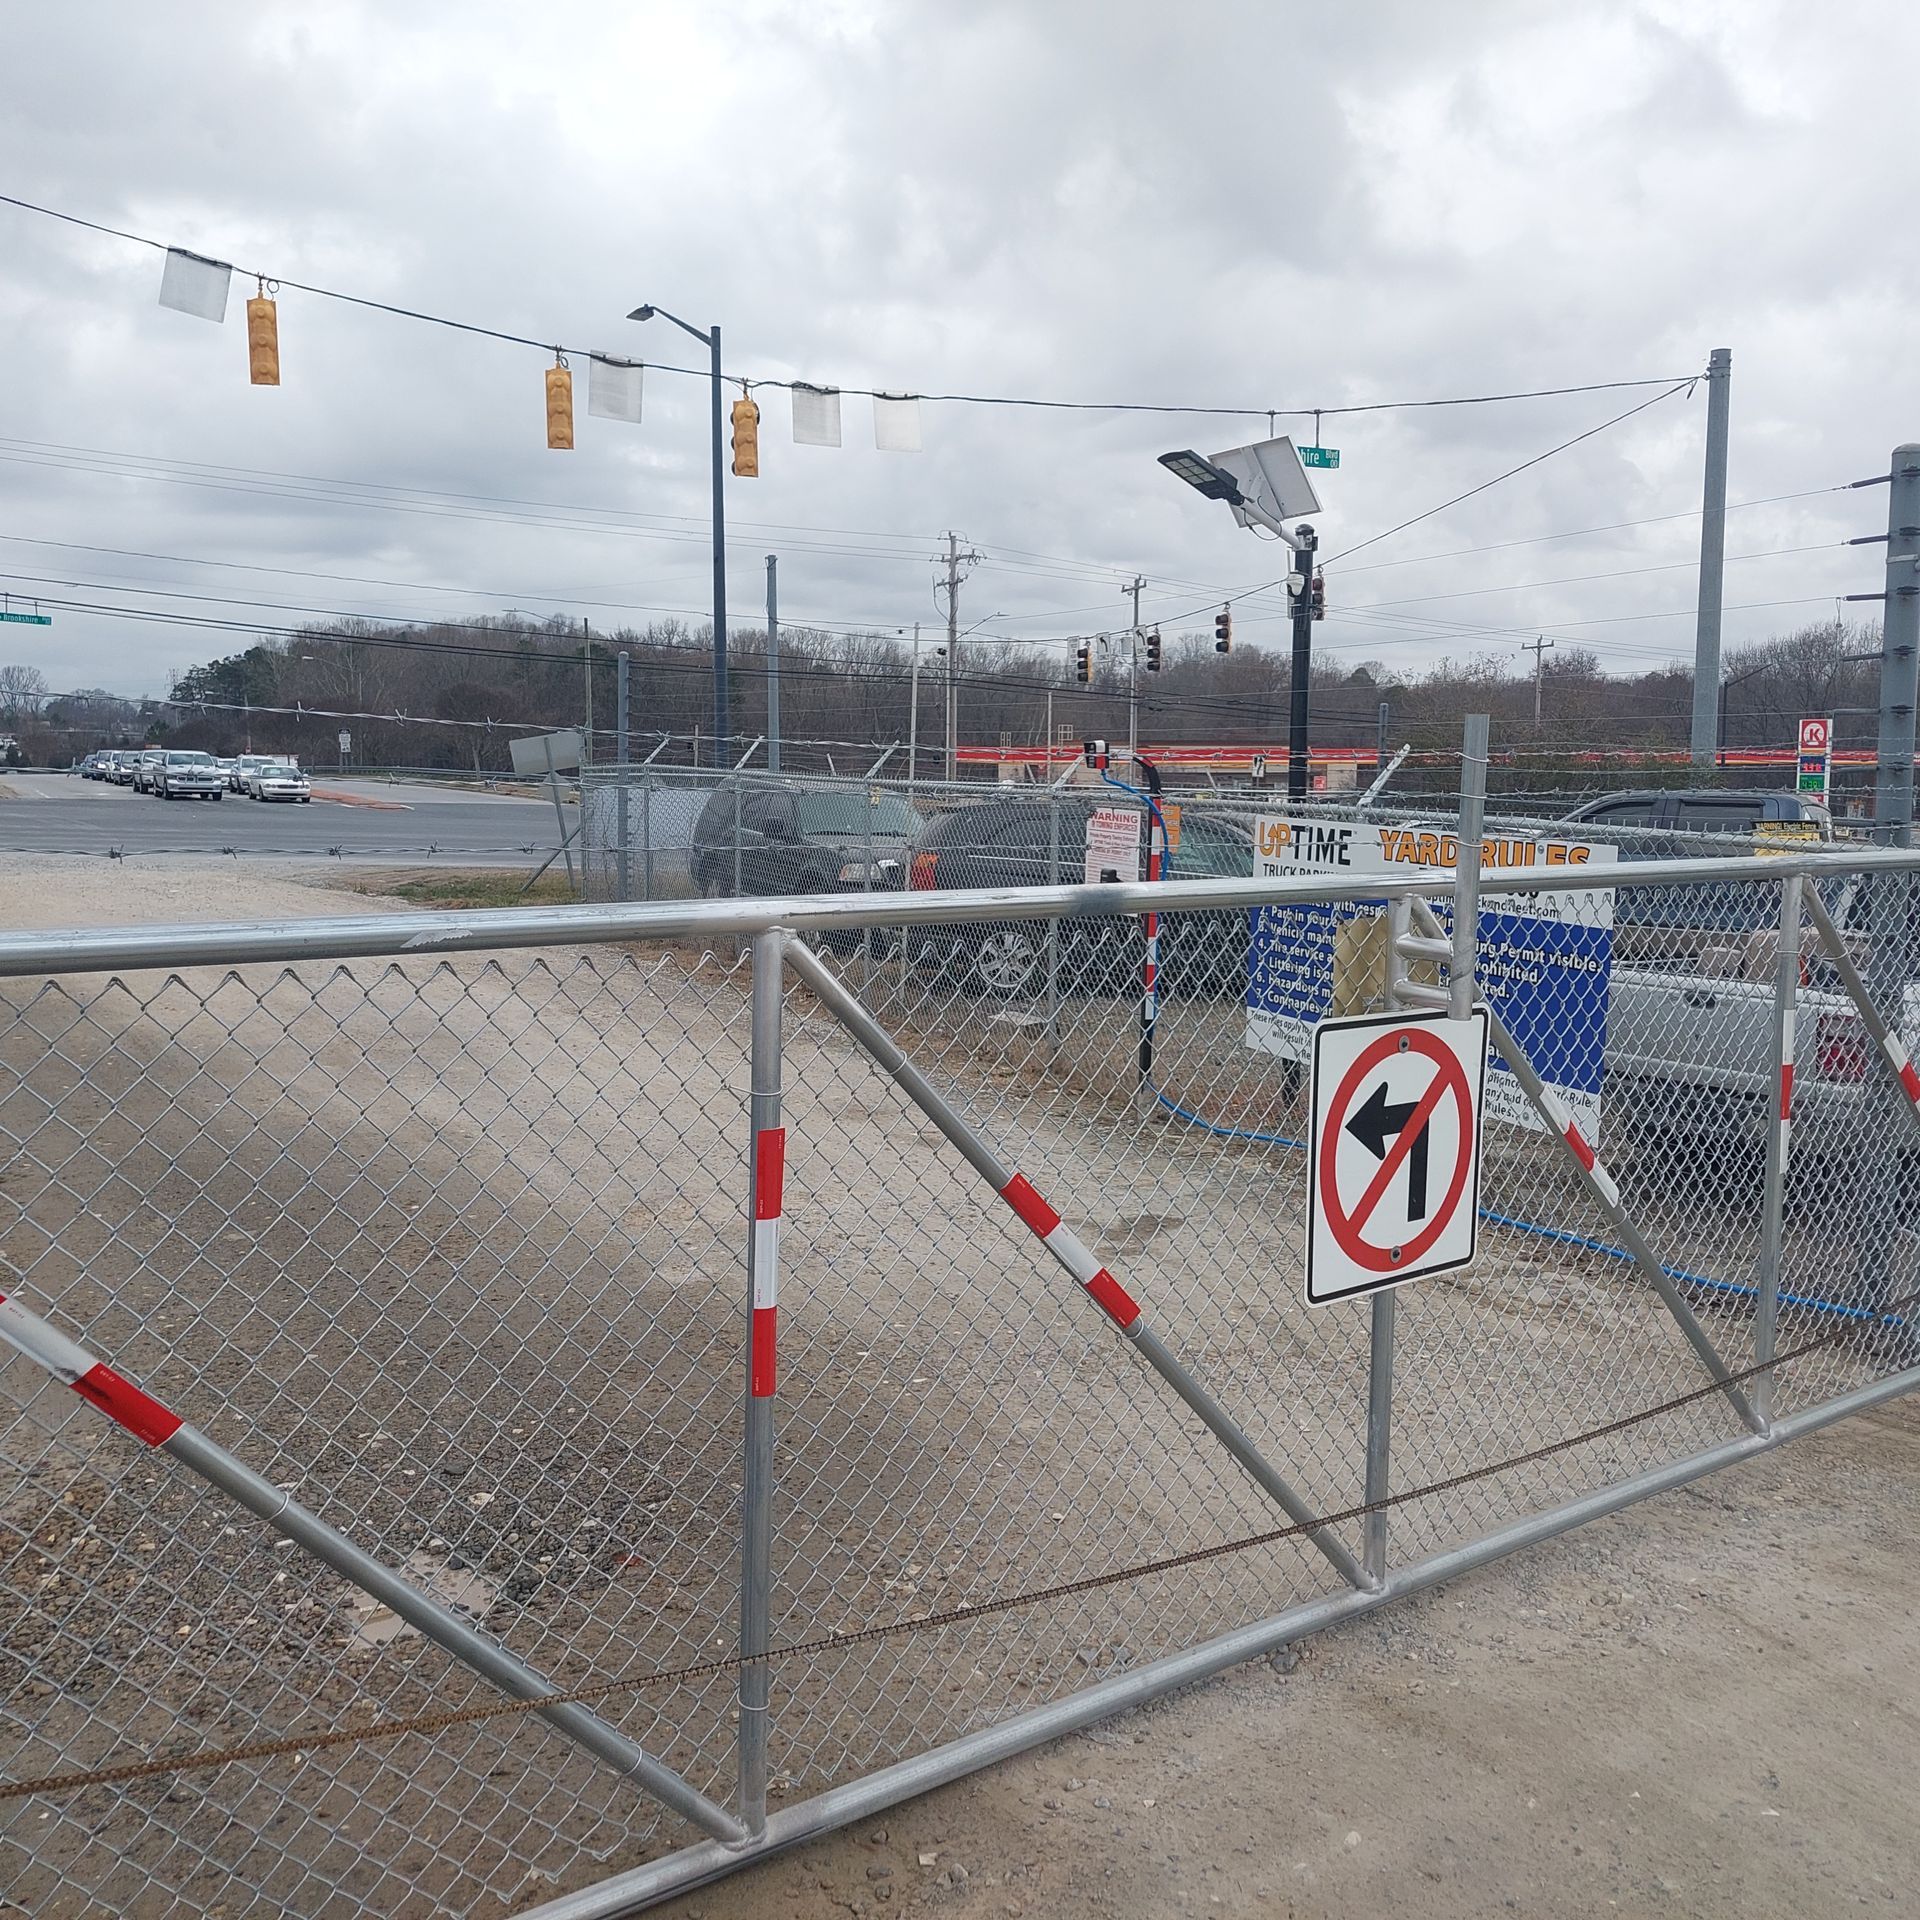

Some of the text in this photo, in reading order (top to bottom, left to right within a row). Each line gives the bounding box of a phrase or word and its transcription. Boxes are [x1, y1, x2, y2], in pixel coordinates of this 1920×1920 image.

[3, 614, 38, 623] Brookshire
[1260, 821, 1353, 866] UPTIME
[1379, 829, 1458, 868] YARD
[1500, 943, 1545, 963] Permit
[1256, 971, 1266, 984] 6.
[1269, 957, 1311, 979] Littering
